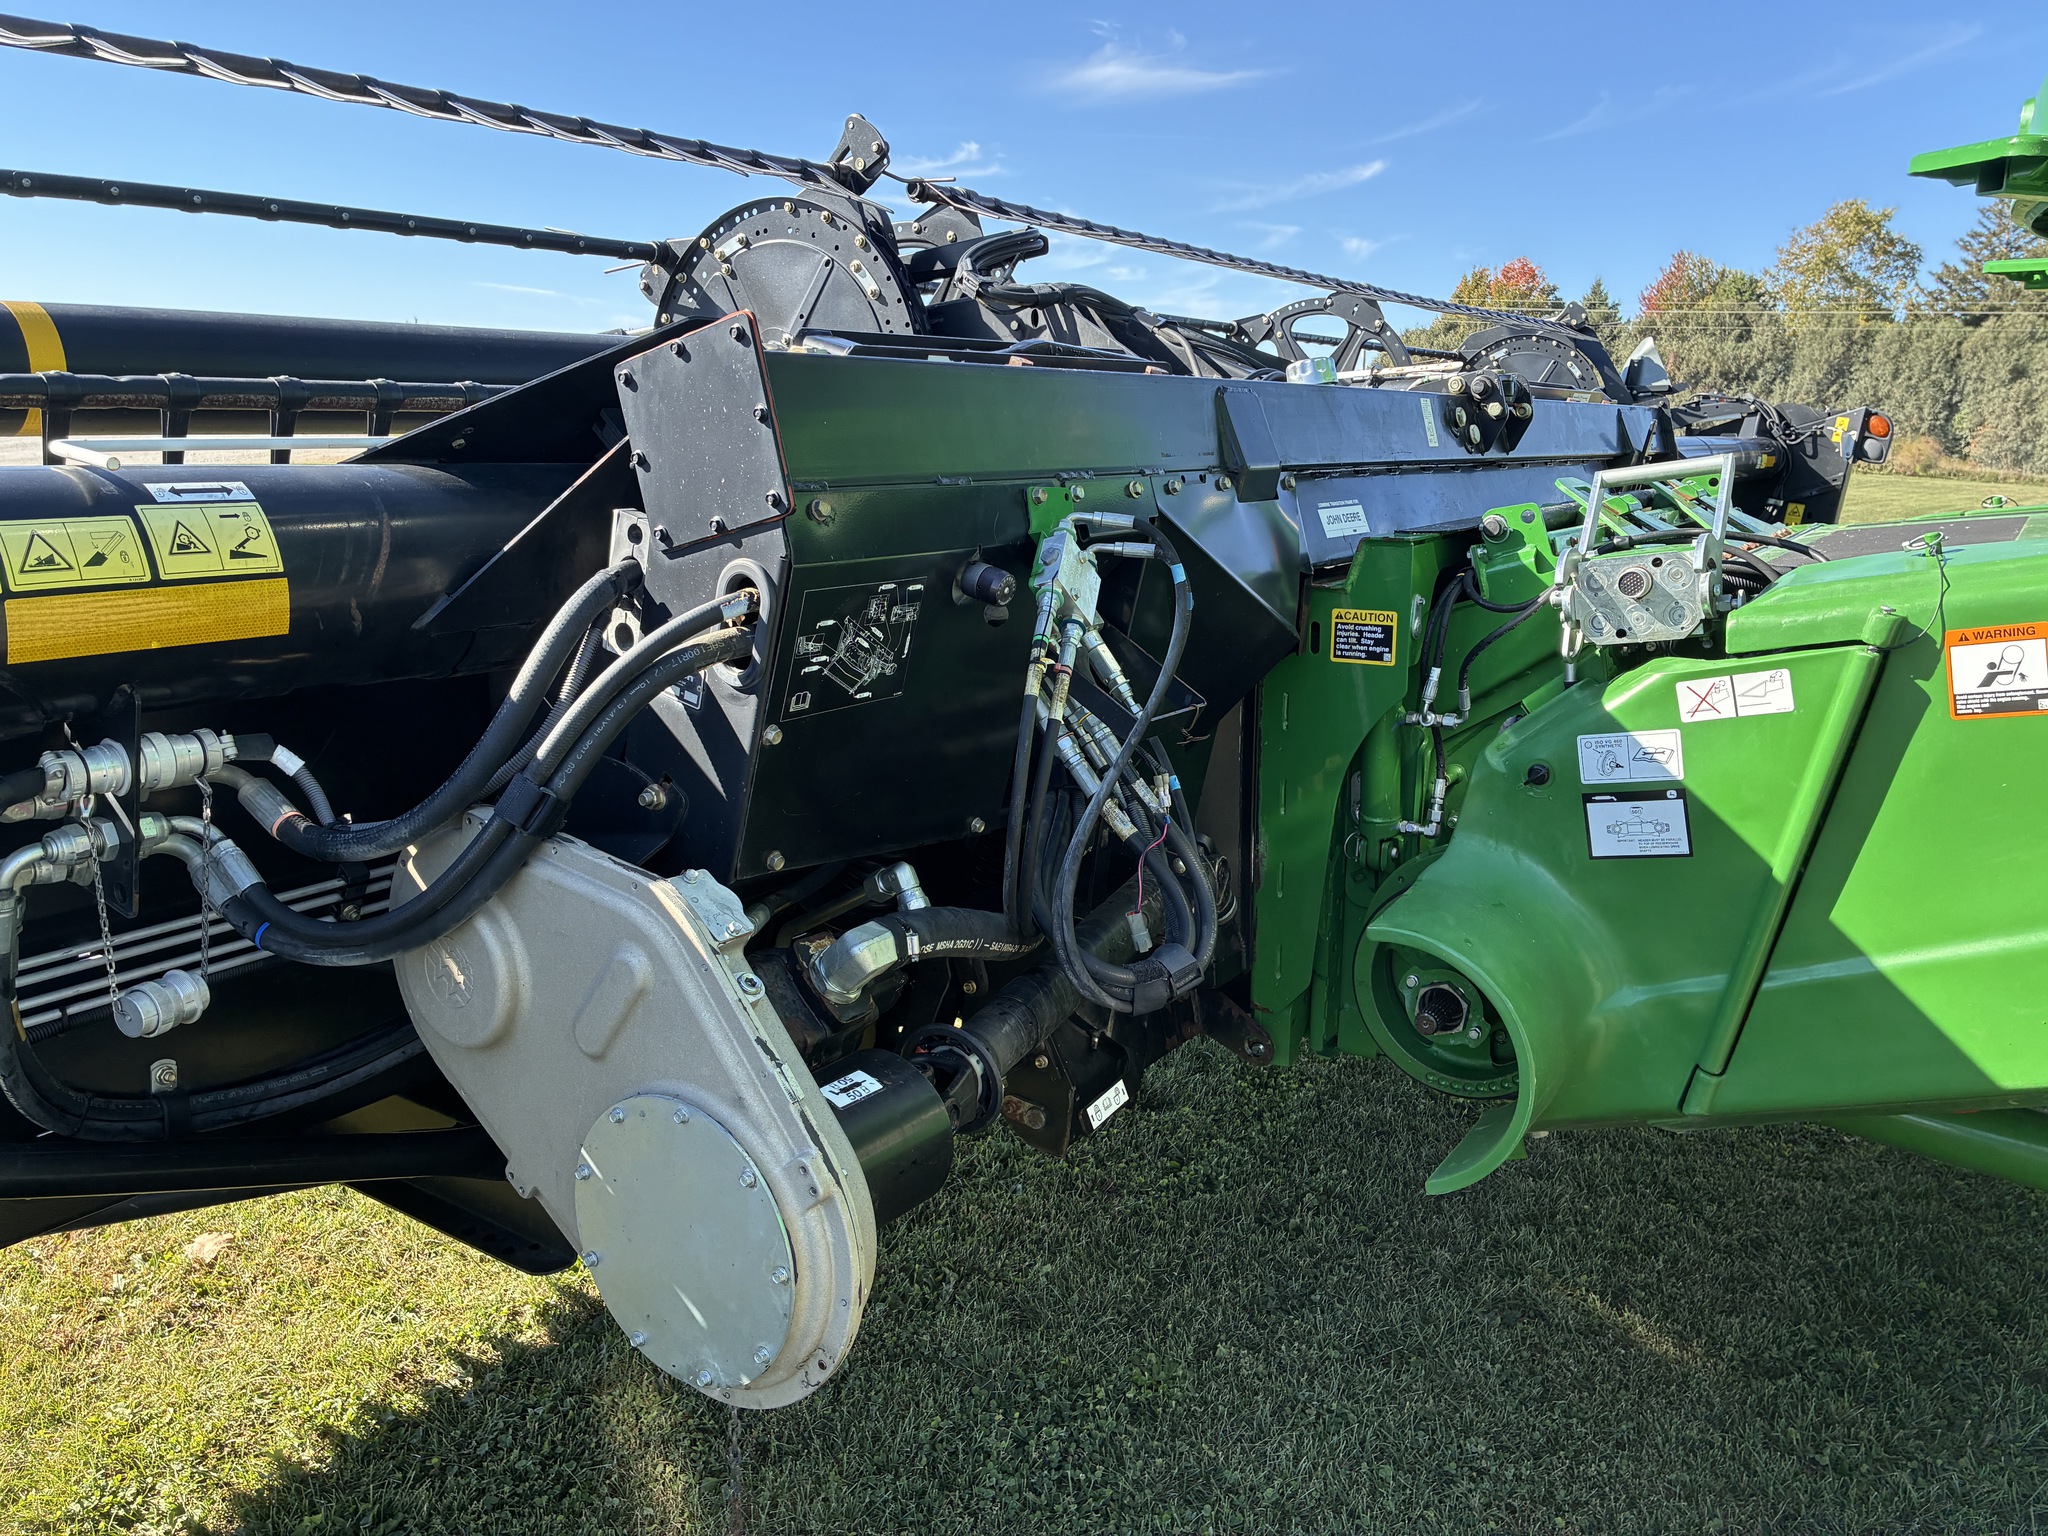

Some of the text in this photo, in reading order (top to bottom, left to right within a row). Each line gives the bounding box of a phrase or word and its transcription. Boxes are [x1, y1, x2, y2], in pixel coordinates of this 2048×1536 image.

[1326, 511, 1362, 525] JOHN DEERE
[1344, 611, 1394, 623] CAUTION
[1336, 630, 1385, 639] injuries. Header
[1972, 626, 2036, 641] WARNING
[1360, 638, 1375, 646] Stay
[1342, 651, 1367, 659] running.
[847, 1088, 863, 1102] 50
